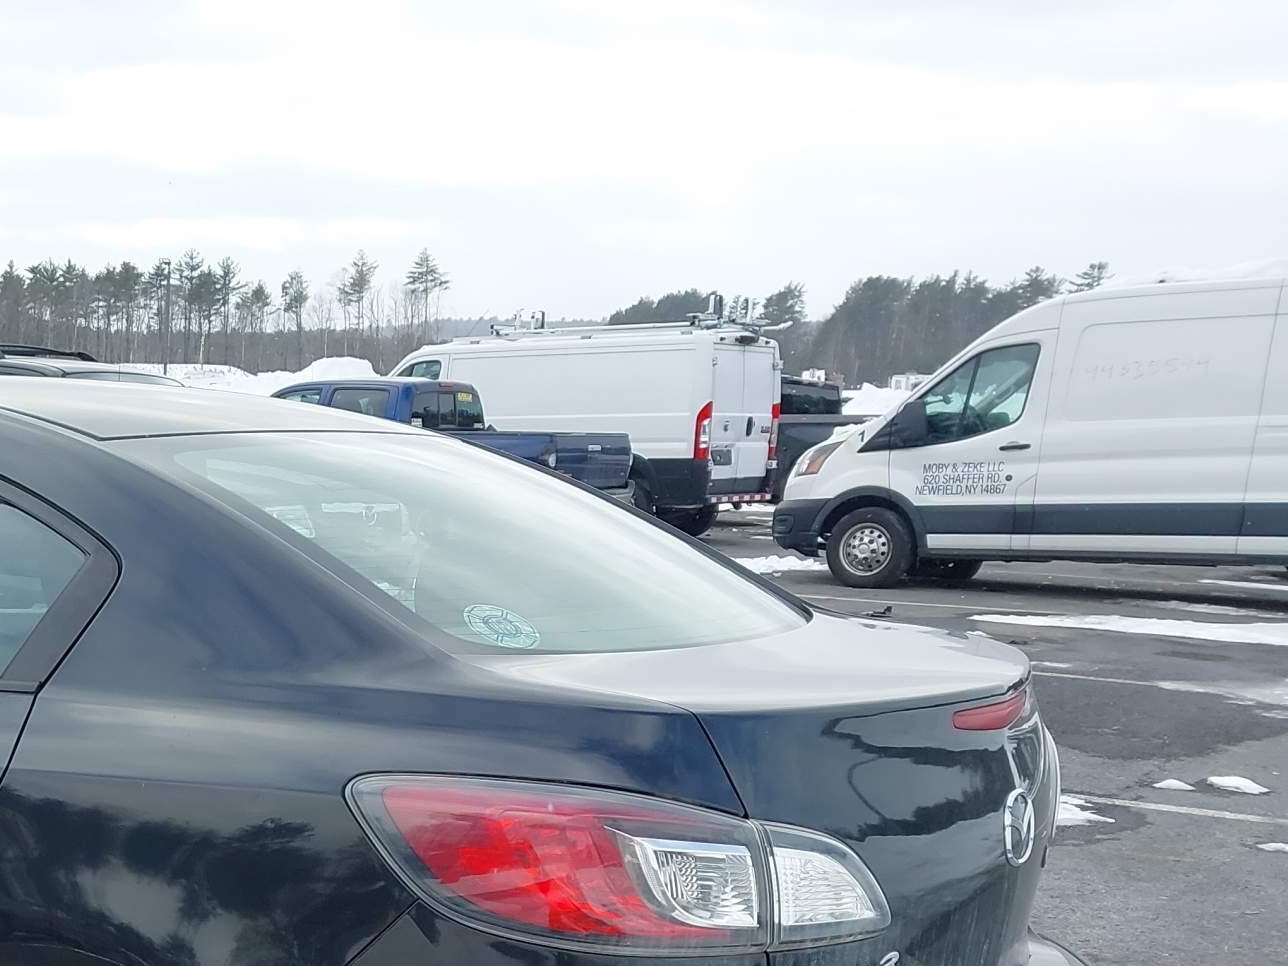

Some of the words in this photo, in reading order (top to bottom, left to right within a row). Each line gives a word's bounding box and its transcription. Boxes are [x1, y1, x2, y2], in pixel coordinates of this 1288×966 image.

[923, 463, 950, 474] MOBY
[952, 463, 959, 473] &
[961, 462, 985, 472] ZEKE
[987, 461, 1005, 472] LLC
[923, 474, 941, 485] 620
[942, 473, 984, 484] SHAFFER
[986, 473, 1002, 483] RD.
[980, 484, 1007, 494] 14867
